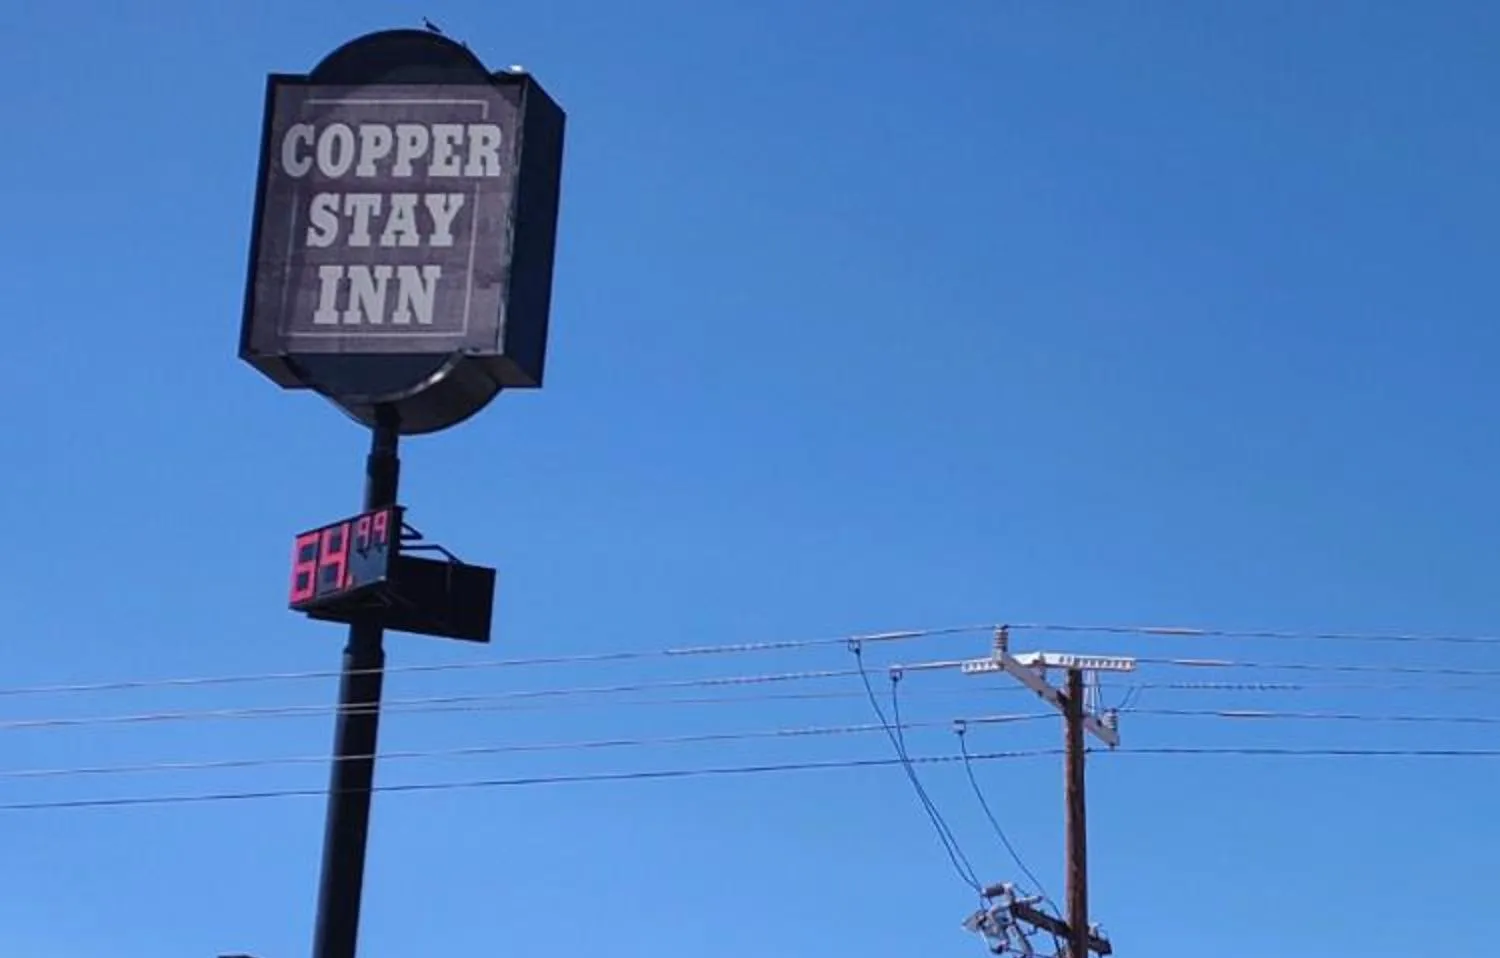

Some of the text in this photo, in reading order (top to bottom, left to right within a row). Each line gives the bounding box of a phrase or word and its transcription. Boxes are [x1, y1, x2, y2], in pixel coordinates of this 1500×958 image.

[281, 123, 501, 178] COPPER
[306, 193, 465, 247] STAY
[313, 264, 442, 324] INN
